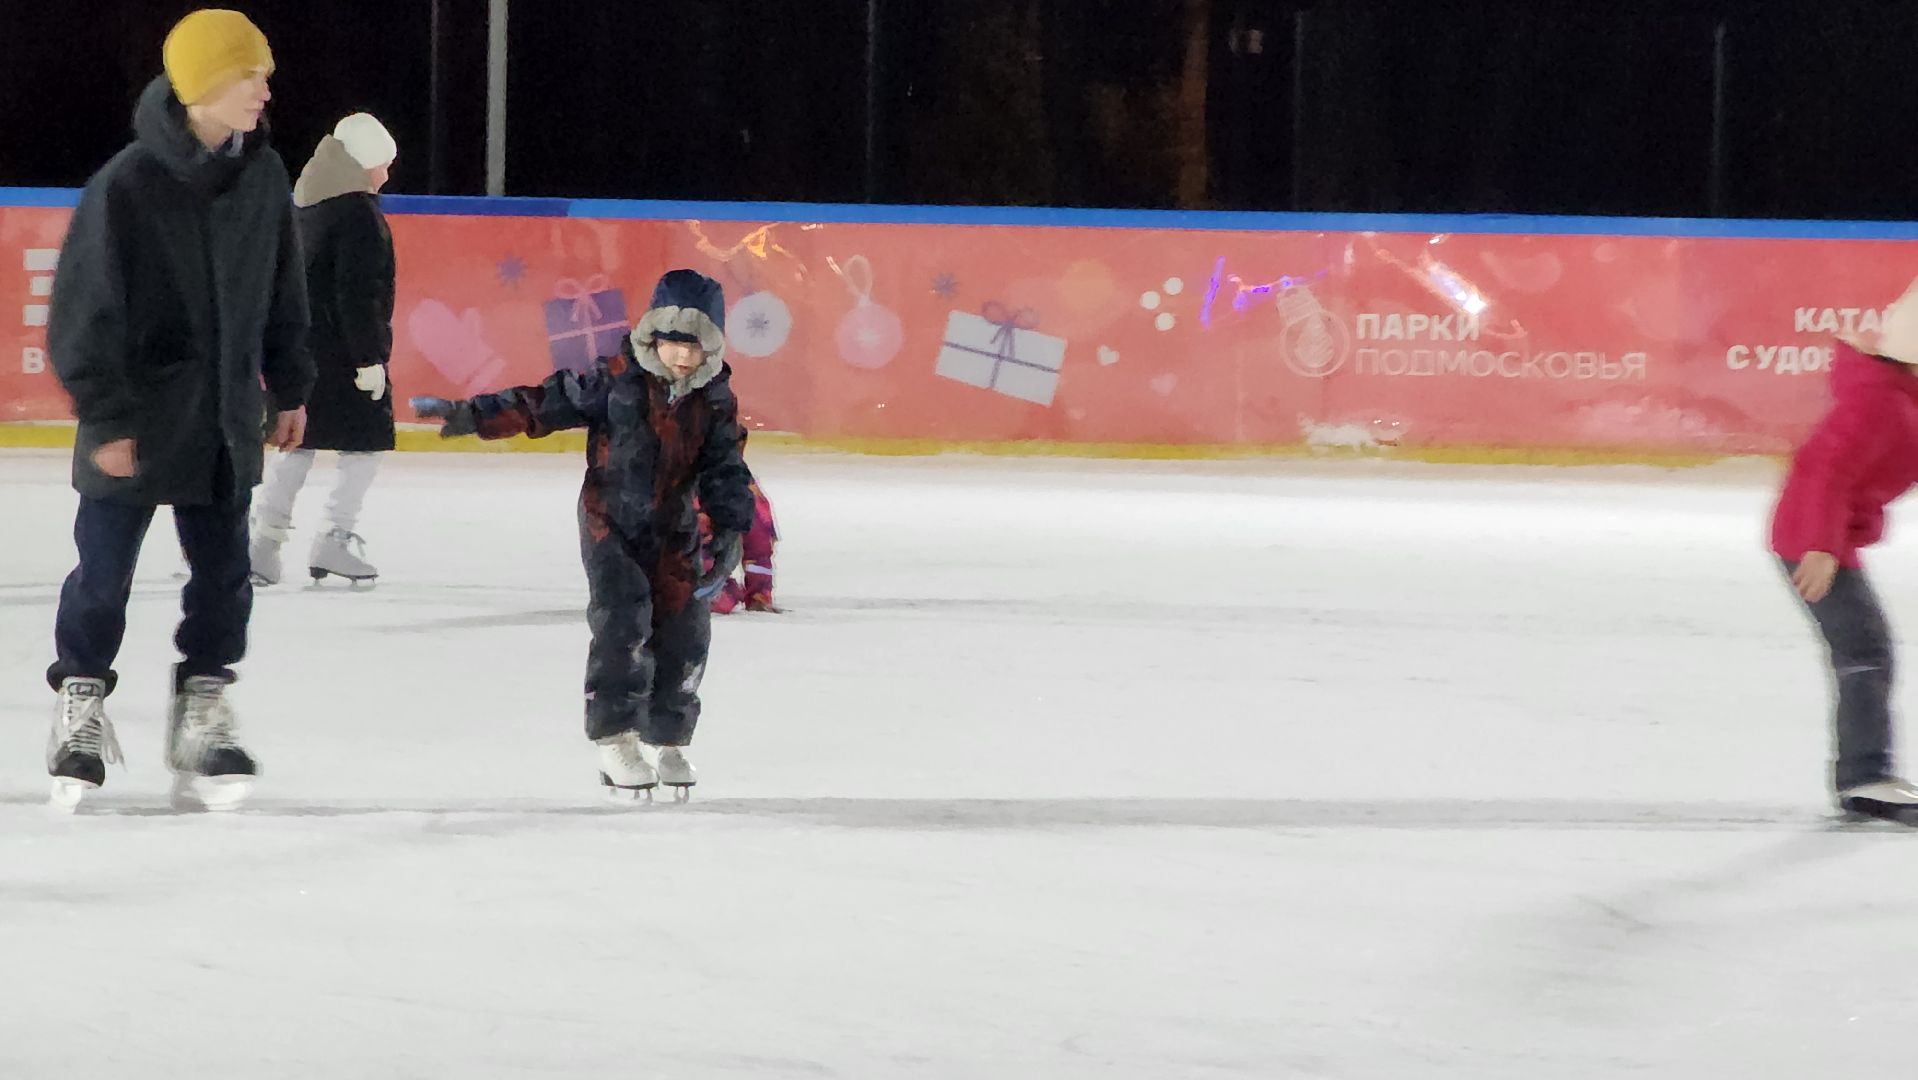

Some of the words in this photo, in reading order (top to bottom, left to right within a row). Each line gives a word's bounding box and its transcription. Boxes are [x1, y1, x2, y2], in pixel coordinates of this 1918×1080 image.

[1356, 313, 1480, 340] ПАРКИ
[1355, 349, 1647, 379] ПОДМОСКОВЬЯ
[1726, 344, 1750, 370] С
